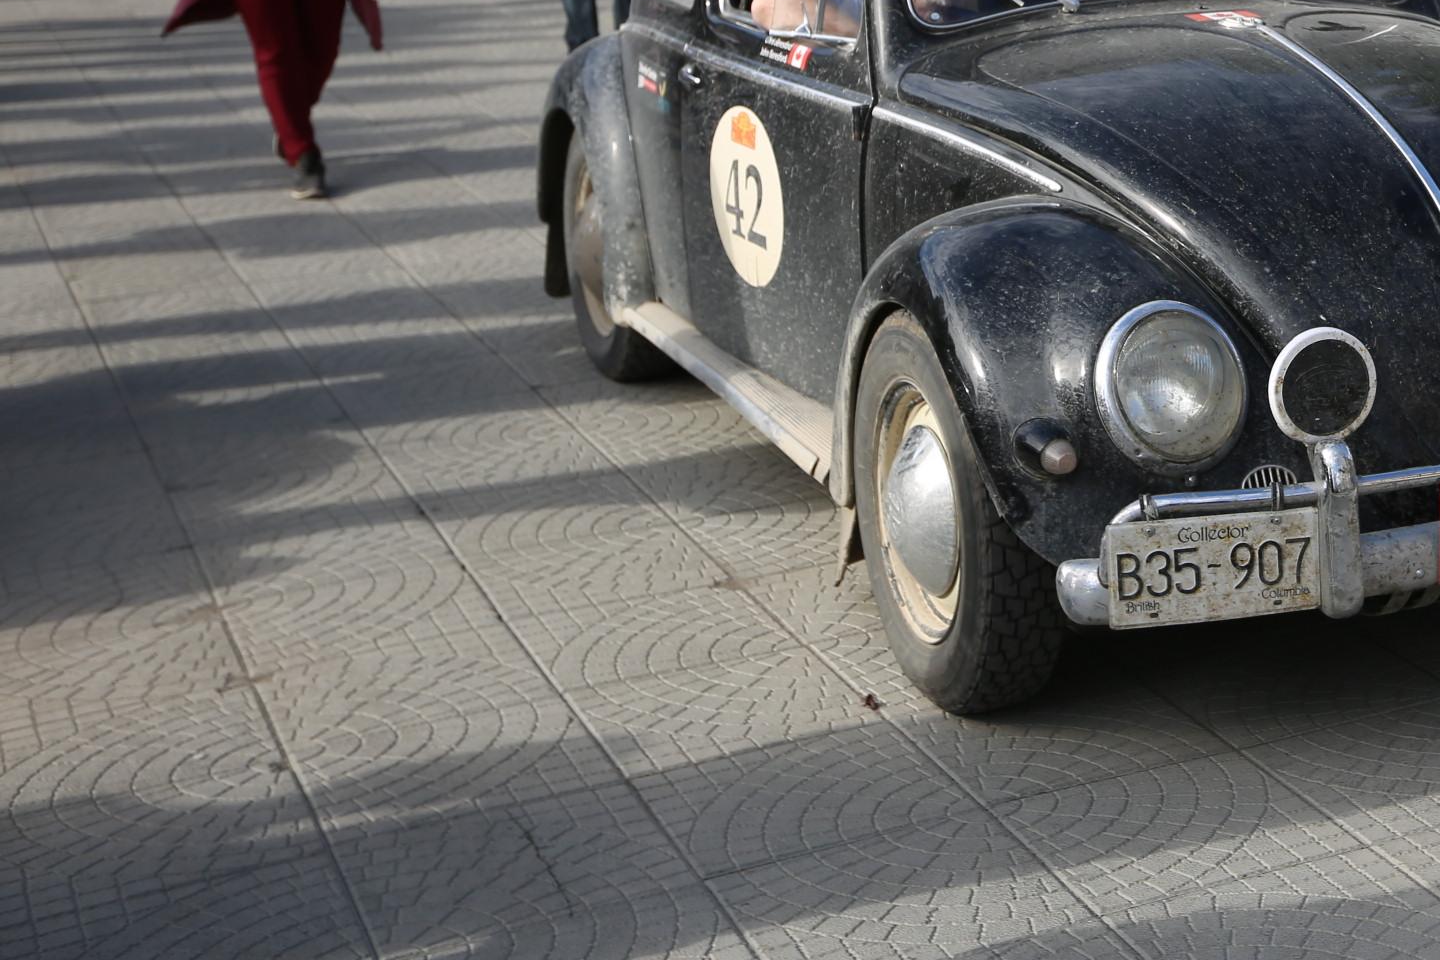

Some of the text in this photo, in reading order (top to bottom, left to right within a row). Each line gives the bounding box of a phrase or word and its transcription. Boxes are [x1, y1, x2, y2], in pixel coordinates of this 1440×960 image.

[725, 159, 767, 251] 42
[1177, 525, 1250, 544] Collector
[1126, 600, 1160, 615] British
